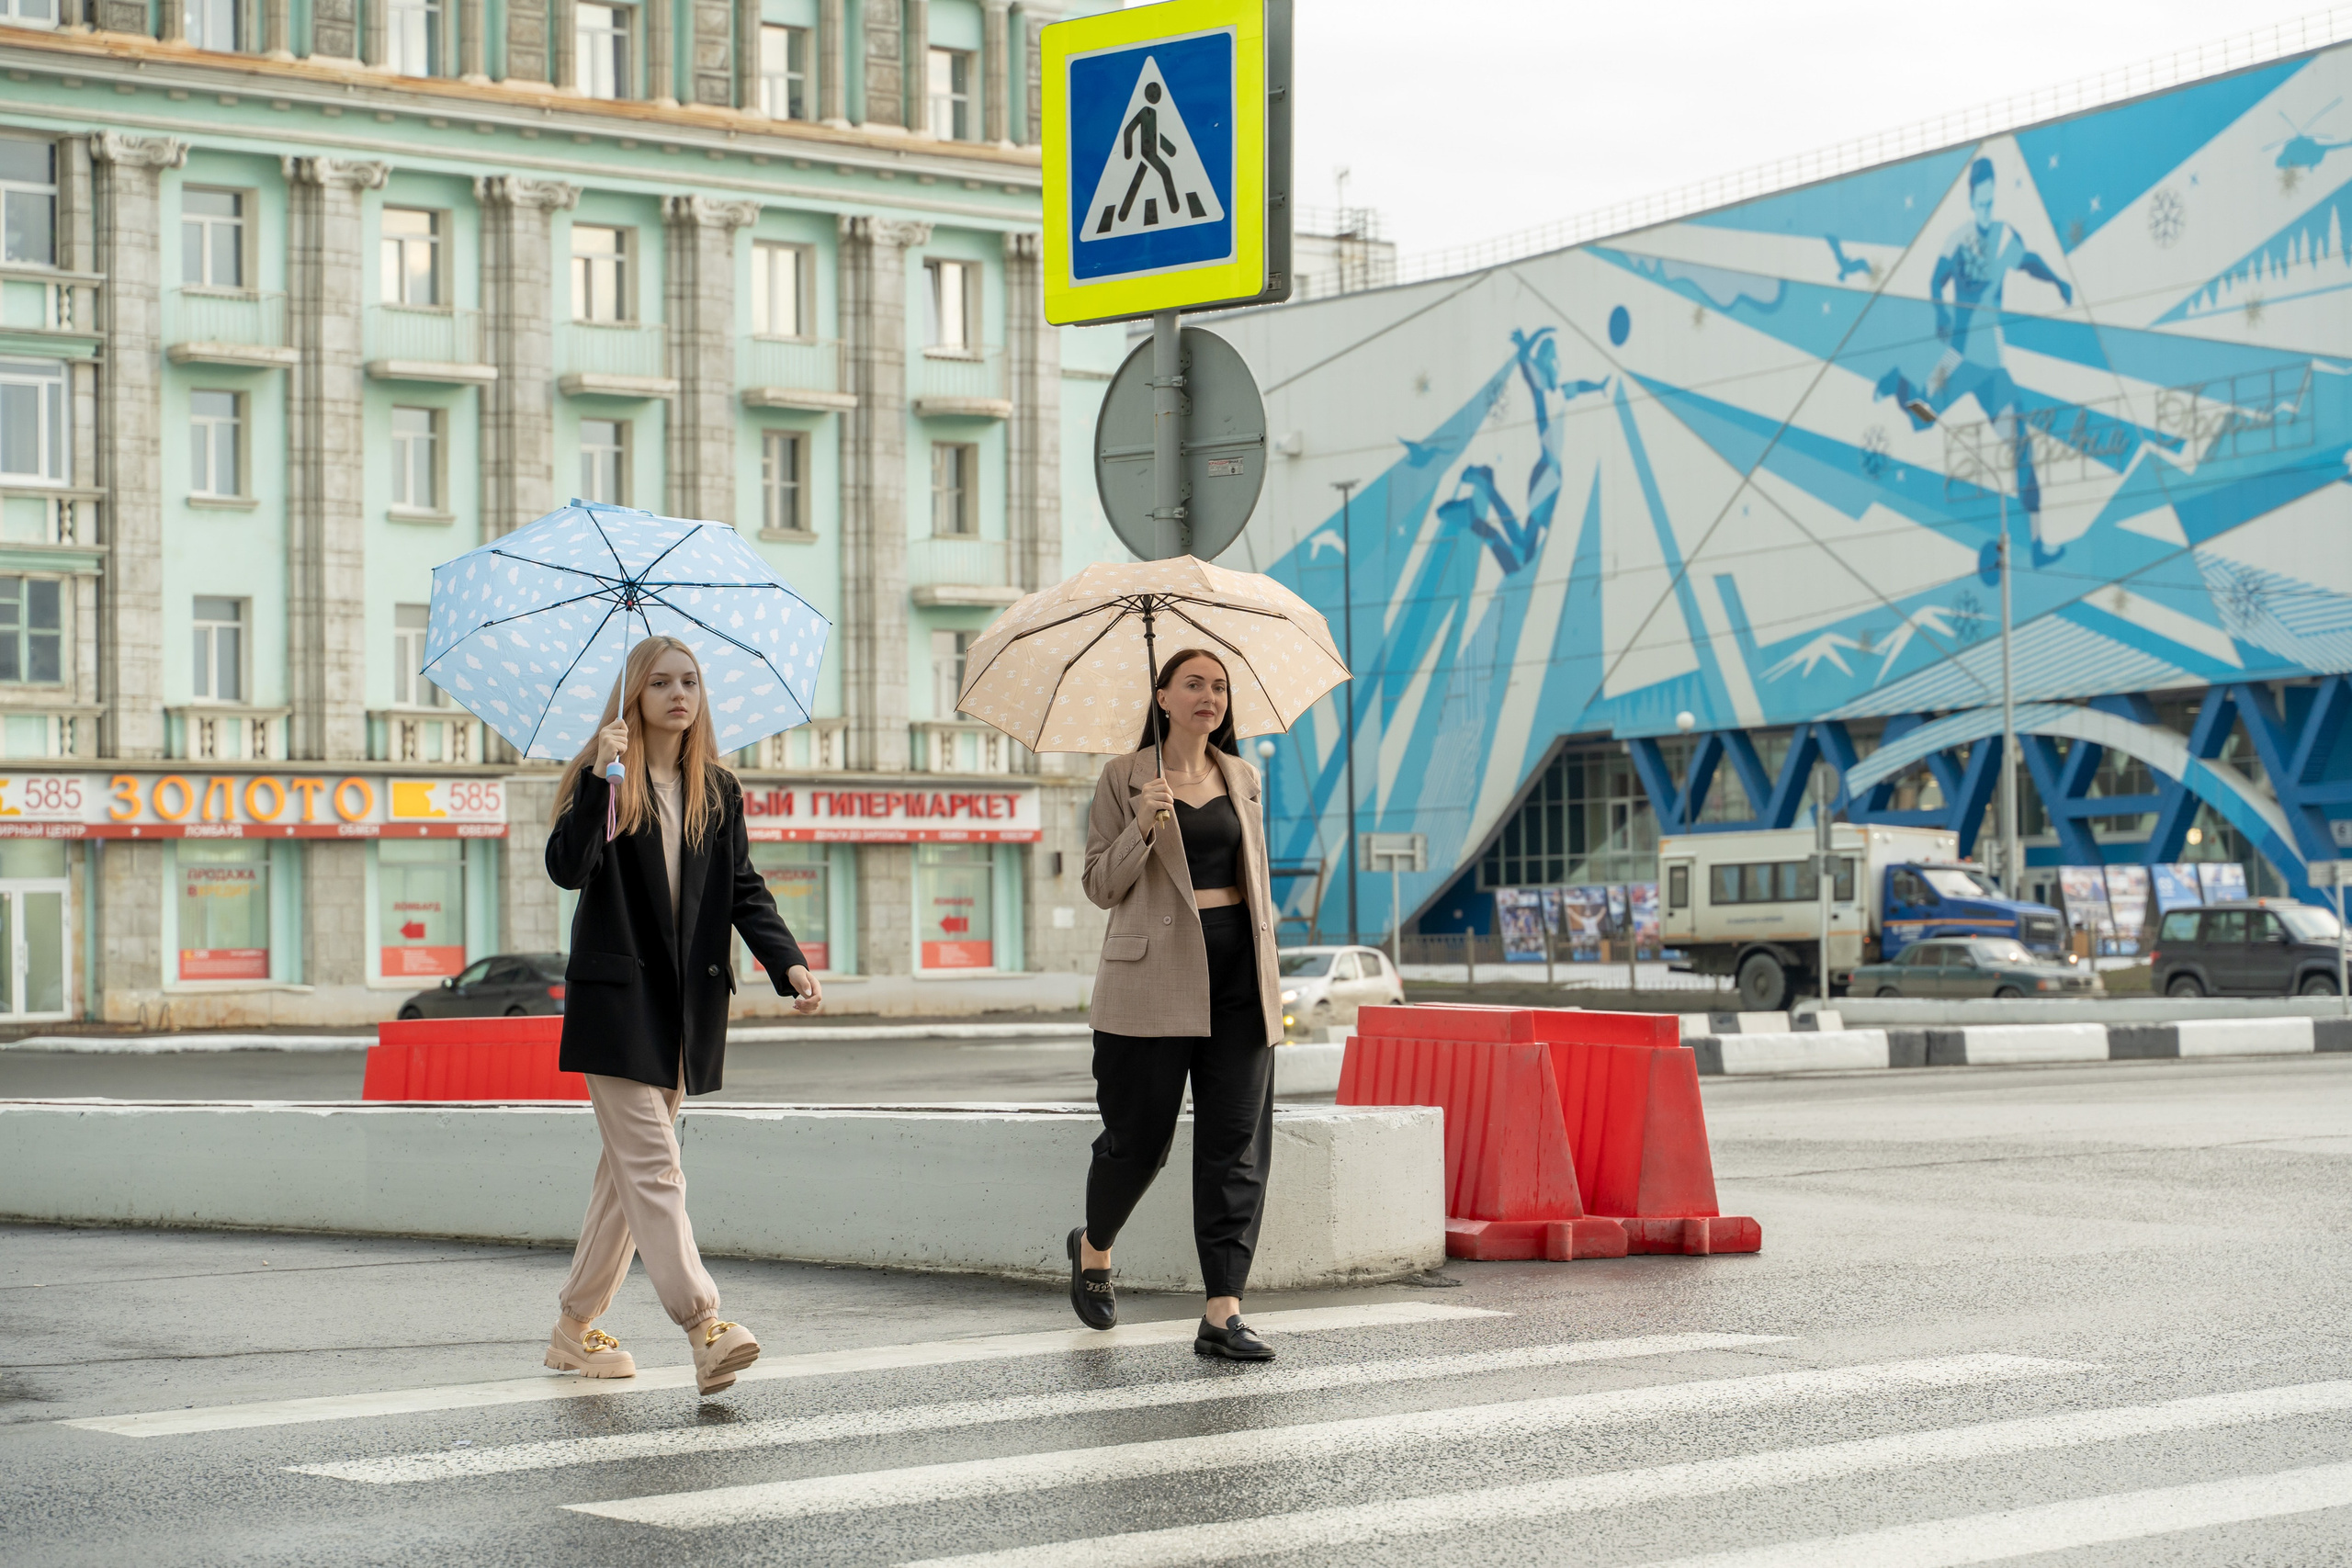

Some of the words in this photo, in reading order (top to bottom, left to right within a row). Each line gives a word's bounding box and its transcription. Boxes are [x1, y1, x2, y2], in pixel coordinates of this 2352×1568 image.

[25, 778, 82, 809] 585
[108, 774, 375, 823] ЗОЛОТО
[450, 782, 501, 811] 585
[812, 791, 1021, 818] ГИПЕРМАРКЕТ
[46, 823, 87, 839] ЦЕНТР
[185, 825, 243, 838] ЛОМБАРД
[337, 823, 380, 837] ОБМЕН
[457, 824, 505, 837] ЮВЕЛИР
[187, 868, 256, 881] ПРОДАЖА
[393, 901, 442, 912] ЛОМБАРД
